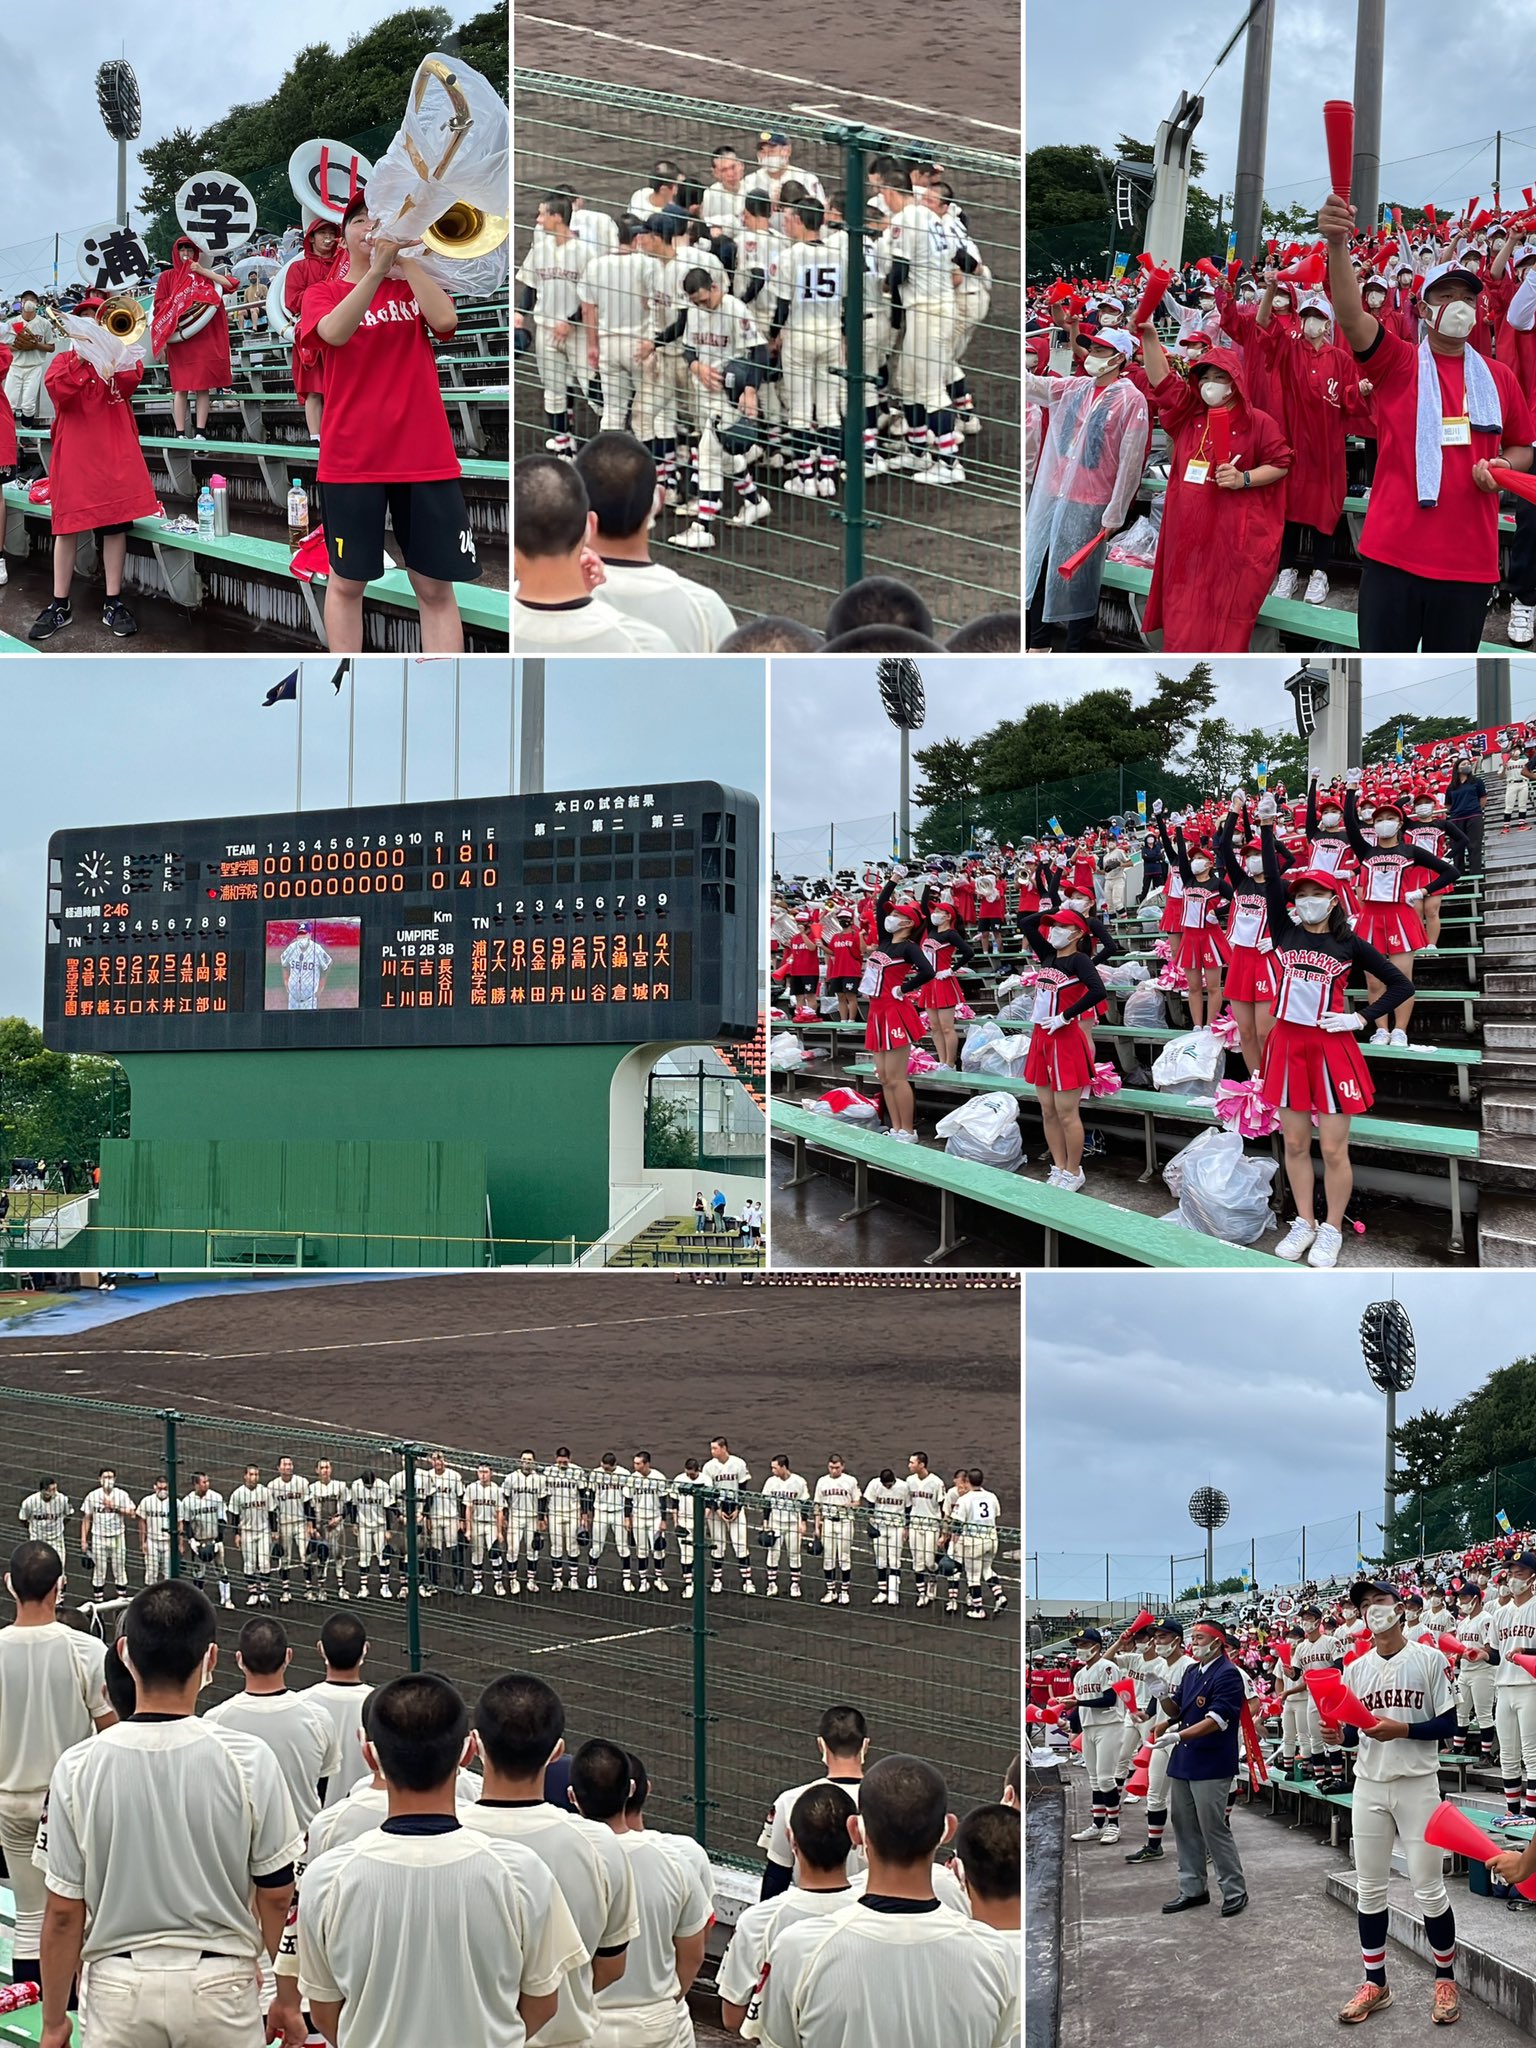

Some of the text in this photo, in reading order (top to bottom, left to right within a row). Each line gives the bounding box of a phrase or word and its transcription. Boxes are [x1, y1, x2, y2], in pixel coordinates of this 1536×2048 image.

[184, 182, 250, 250] 学
[84, 227, 148, 289] 浦
[804, 267, 836, 299] 15
[554, 793, 655, 814] 本日の試合結果
[226, 827, 495, 857] TEAM 1 2 3 4 5 6 7 8 9 10 R H E
[123, 855, 131, 867] B
[164, 853, 172, 864] H
[220, 859, 259, 877] 聖望学園
[460, 844, 472, 863] 8
[123, 869, 131, 881] S
[164, 867, 172, 878] E
[836, 870, 859, 892] 学
[122, 884, 131, 895] O
[162, 881, 173, 892] Fc
[219, 883, 258, 901] 浦和学院
[432, 871, 444, 890] 0
[459, 870, 471, 888] 4
[483, 868, 496, 887] 0
[806, 879, 833, 900] 浦
[65, 905, 101, 918] 経過時間
[103, 903, 129, 918] 2:46
[496, 893, 668, 914] 1 2 3 4 5 6 7 8 9
[87, 916, 226, 934] 1 2 3 4 5 6 7 8 9
[433, 911, 453, 923] Km
[472, 917, 490, 930] TN
[67, 937, 82, 948] TN
[396, 929, 440, 942] UMPIRE
[382, 943, 454, 957] PL 1B 2B 3B
[1280, 949, 1342, 976] URAGAKU
[471, 940, 487, 1005] 浦和学院
[1284, 968, 1332, 985] FIRE REDS
[64, 958, 80, 1016] 聖望学園
[979, 1502, 989, 1518] 3
